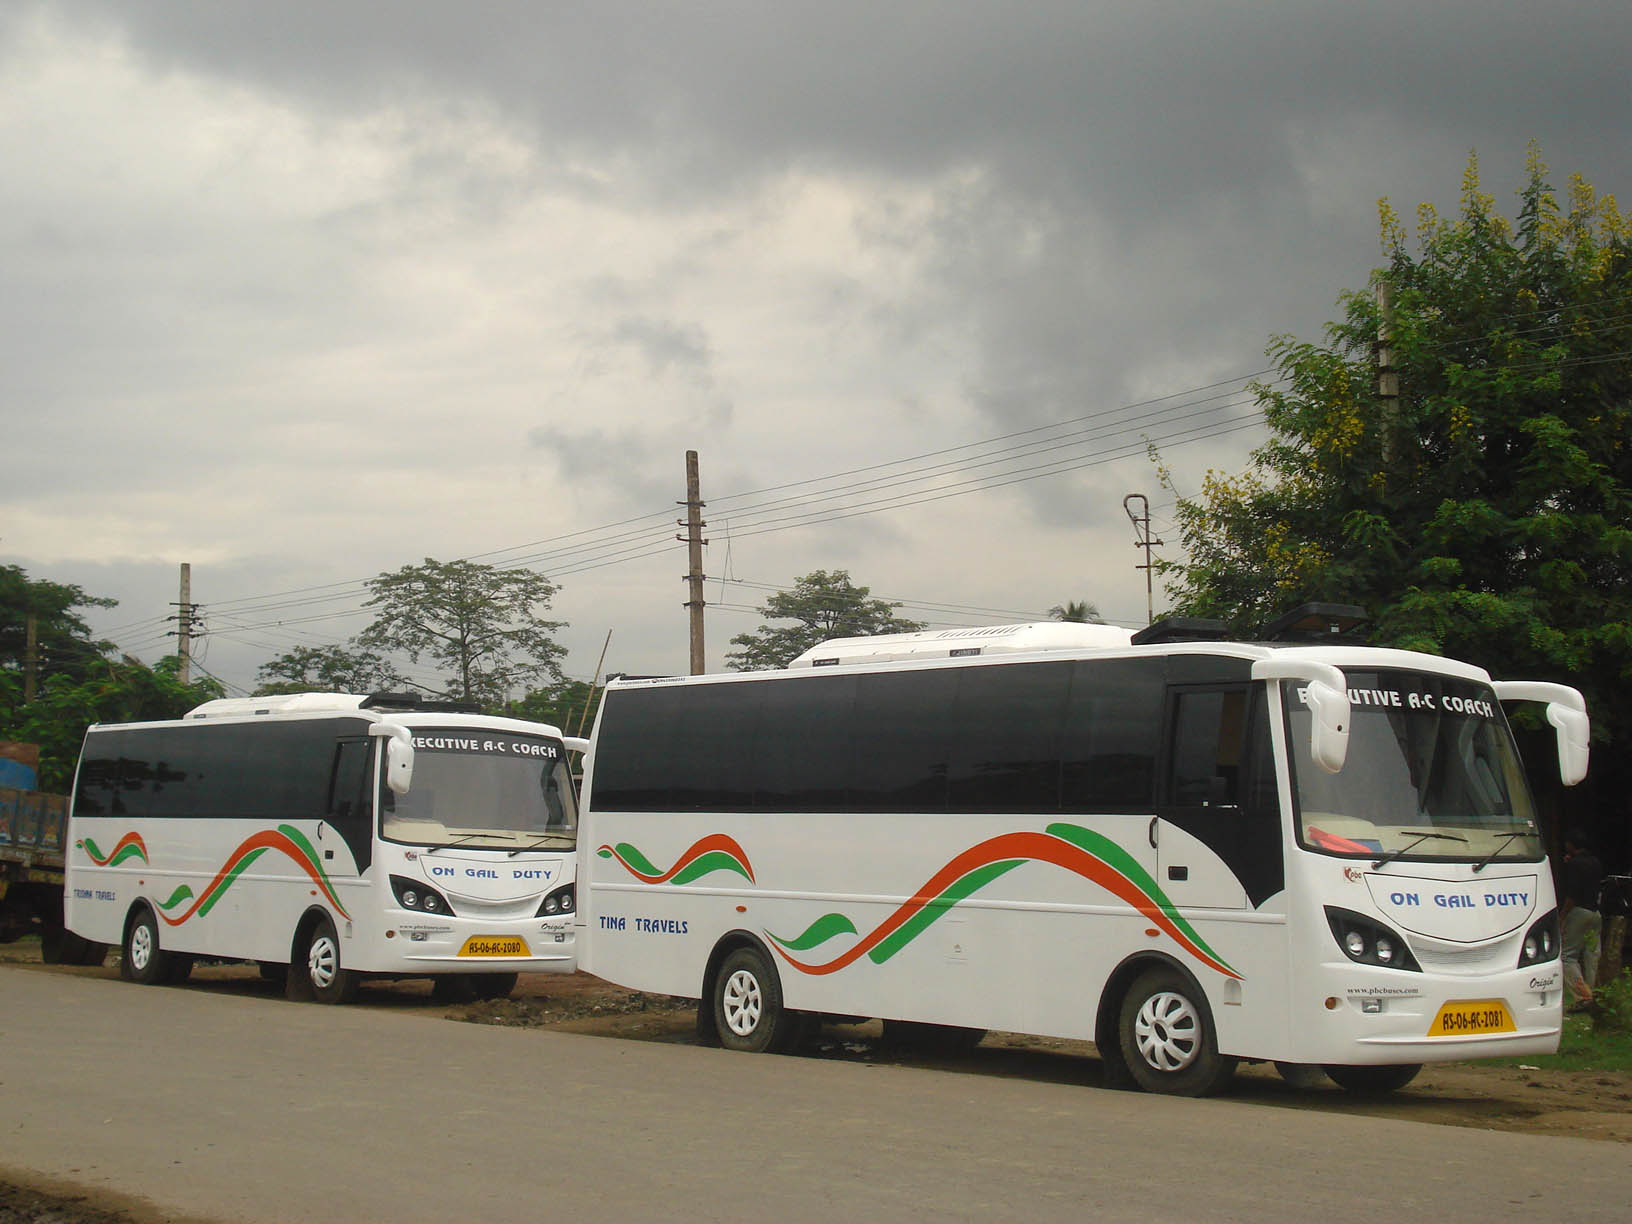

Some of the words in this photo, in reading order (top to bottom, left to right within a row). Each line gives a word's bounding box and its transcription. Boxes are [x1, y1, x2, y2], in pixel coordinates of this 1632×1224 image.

[1297, 688, 1402, 707] EUTIVE
[1442, 696, 1494, 717] COACH
[411, 737, 479, 750] XECUTIVE
[512, 743, 557, 758] COACH
[432, 867, 456, 877] ON
[465, 868, 499, 879] GAIL
[512, 870, 553, 880] DUTY
[1390, 892, 1420, 906] ON
[1434, 894, 1476, 909] GAIL
[1484, 893, 1529, 907] DUTY
[599, 916, 626, 931] TINA
[635, 918, 689, 934] TRAVELS
[468, 942, 521, 954] AS-06-AC-2080
[1442, 1010, 1504, 1032] AS-06-AC-2081
